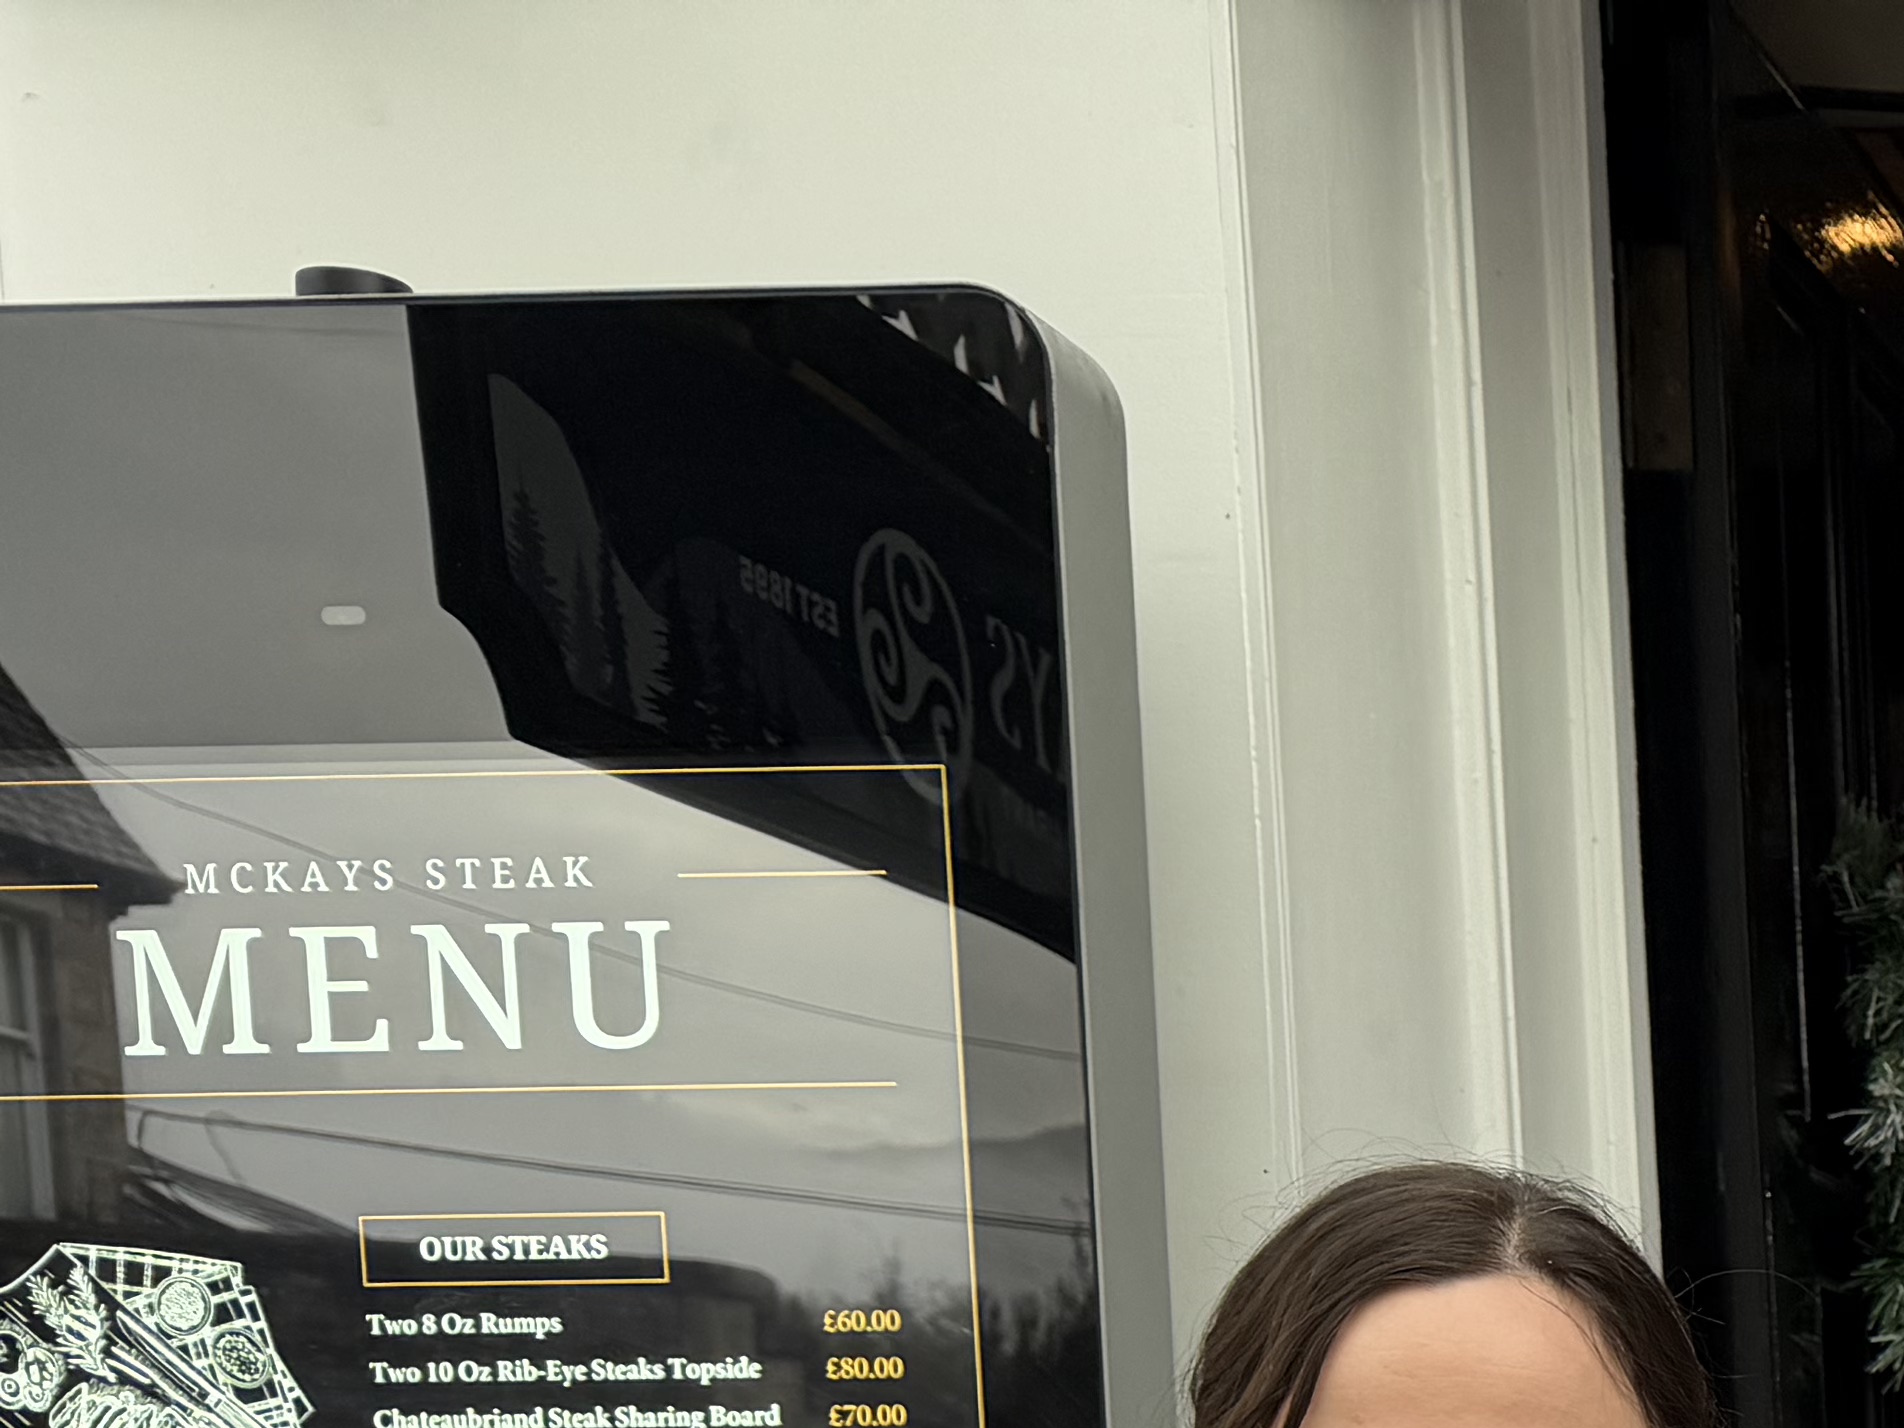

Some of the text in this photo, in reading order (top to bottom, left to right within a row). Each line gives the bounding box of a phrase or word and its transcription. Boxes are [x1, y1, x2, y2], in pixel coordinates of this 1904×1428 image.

[183, 856, 592, 896] MCKAYS STEAK
[115, 919, 671, 1057] MENU
[419, 1234, 608, 1261] OUR STEAKS
[365, 1313, 563, 1339] Two 8 Oz Rumps
[824, 1310, 901, 1332] £60.00
[369, 1356, 762, 1387] Two 10 Oz Rib-Eye Steaks Topside
[826, 1357, 904, 1380] £80.00
[548, 1406, 613, 1428] Steak
[709, 1403, 782, 1427] Board
[829, 1404, 907, 1427] £70.00
